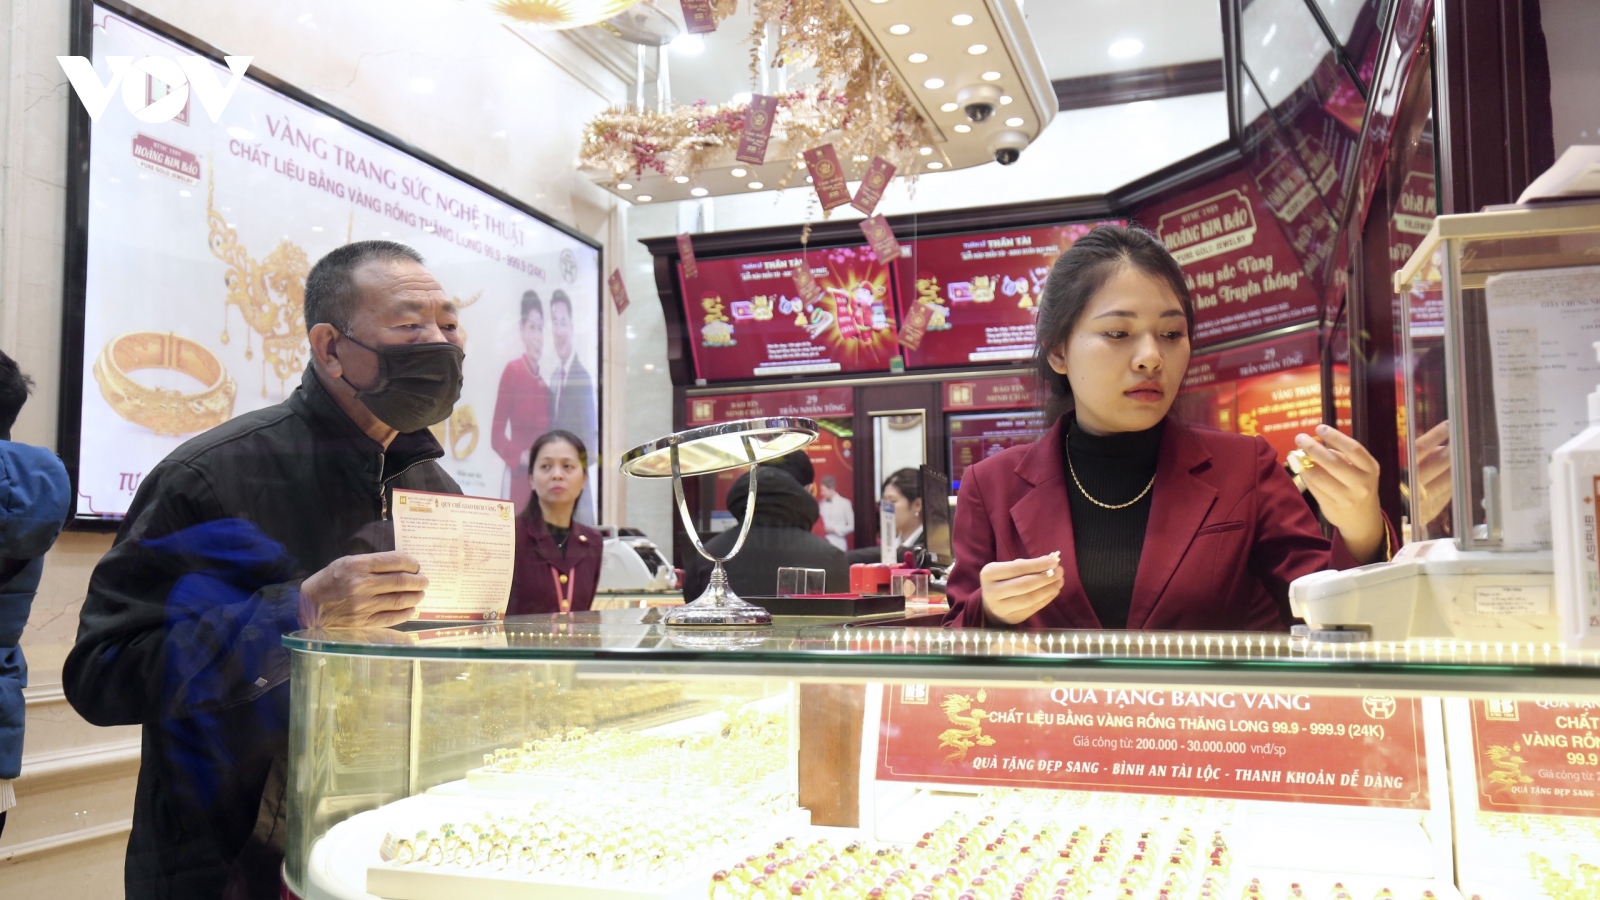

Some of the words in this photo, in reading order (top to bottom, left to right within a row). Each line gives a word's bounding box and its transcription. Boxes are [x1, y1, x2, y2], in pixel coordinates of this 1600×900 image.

[135, 144, 164, 163] HOÀNG
[164, 156, 180, 169] KIM
[181, 160, 198, 176] BẢO
[230, 139, 270, 167] CHẤT
[274, 156, 304, 182] LIỆU
[308, 168, 344, 198] BẰNG
[348, 187, 382, 213] VÀNG
[385, 200, 416, 228] RỒNG
[266, 114, 327, 160] VÀNG
[334, 145, 396, 190] TRANG
[402, 176, 432, 206] SỨC
[436, 192, 480, 231] NGHỆ
[484, 214, 525, 247] THUẬT
[1164, 226, 1200, 250] HOÀNG
[1201, 216, 1223, 236] KIM
[1224, 206, 1248, 232] BẢO
[1015, 235, 1032, 246] TÀI
[1216, 234, 1246, 250] JEWELRY
[1238, 254, 1273, 274] Vàng
[1196, 294, 1217, 310] hoa
[1219, 278, 1261, 303] Truyền
[1264, 348, 1276, 360] 29
[779, 406, 799, 416] TRẦN
[824, 403, 846, 412] TÔNG
[806, 395, 817, 404] 29
[120, 472, 141, 496] TỰ
[1584, 515, 1596, 562] ASIRUB
[989, 707, 1024, 724] CHẤT
[1026, 710, 1054, 727] LIỆU
[1056, 709, 1094, 727] BẰNG
[1096, 712, 1133, 728] VÀNG
[1136, 711, 1176, 730] RỒNG
[1179, 715, 1226, 731] THĂNG
[1230, 720, 1269, 733] LONG
[1272, 722, 1299, 734] 99.9
[1310, 723, 1345, 736] 999.9
[1348, 723, 1385, 740] (24K)
[1555, 712, 1600, 729] CHẤT
[1073, 735, 1089, 747] Giá
[1092, 737, 1117, 751] công
[1120, 736, 1133, 749] từ:
[1136, 738, 1178, 750] 200.000
[1187, 740, 1246, 753] 30.000.000
[1250, 742, 1286, 757] vnđ/sp
[1522, 731, 1568, 747] VÀNG
[1566, 752, 1598, 766] 99.9
[972, 754, 998, 769] QUÀ
[1002, 756, 1034, 772] TẶNG
[1037, 759, 1062, 773] ĐẸP
[1065, 760, 1099, 774] SANG
[1112, 759, 1144, 776] BÌNH
[1148, 765, 1167, 777] AN
[1171, 764, 1192, 779] TÀI
[1196, 764, 1221, 780] LỘC
[1234, 769, 1281, 783] THANH
[1286, 768, 1336, 786] KHOẢN
[1340, 769, 1360, 786] DỄ
[1364, 772, 1403, 789] DÀNG
[1538, 768, 1554, 779] Giá
[1556, 770, 1580, 782] công
[1582, 770, 1594, 780] từ:
[1511, 786, 1528, 794] QUÀ
[1530, 786, 1551, 796] TẶNG
[1554, 788, 1570, 797] ĐẸP
